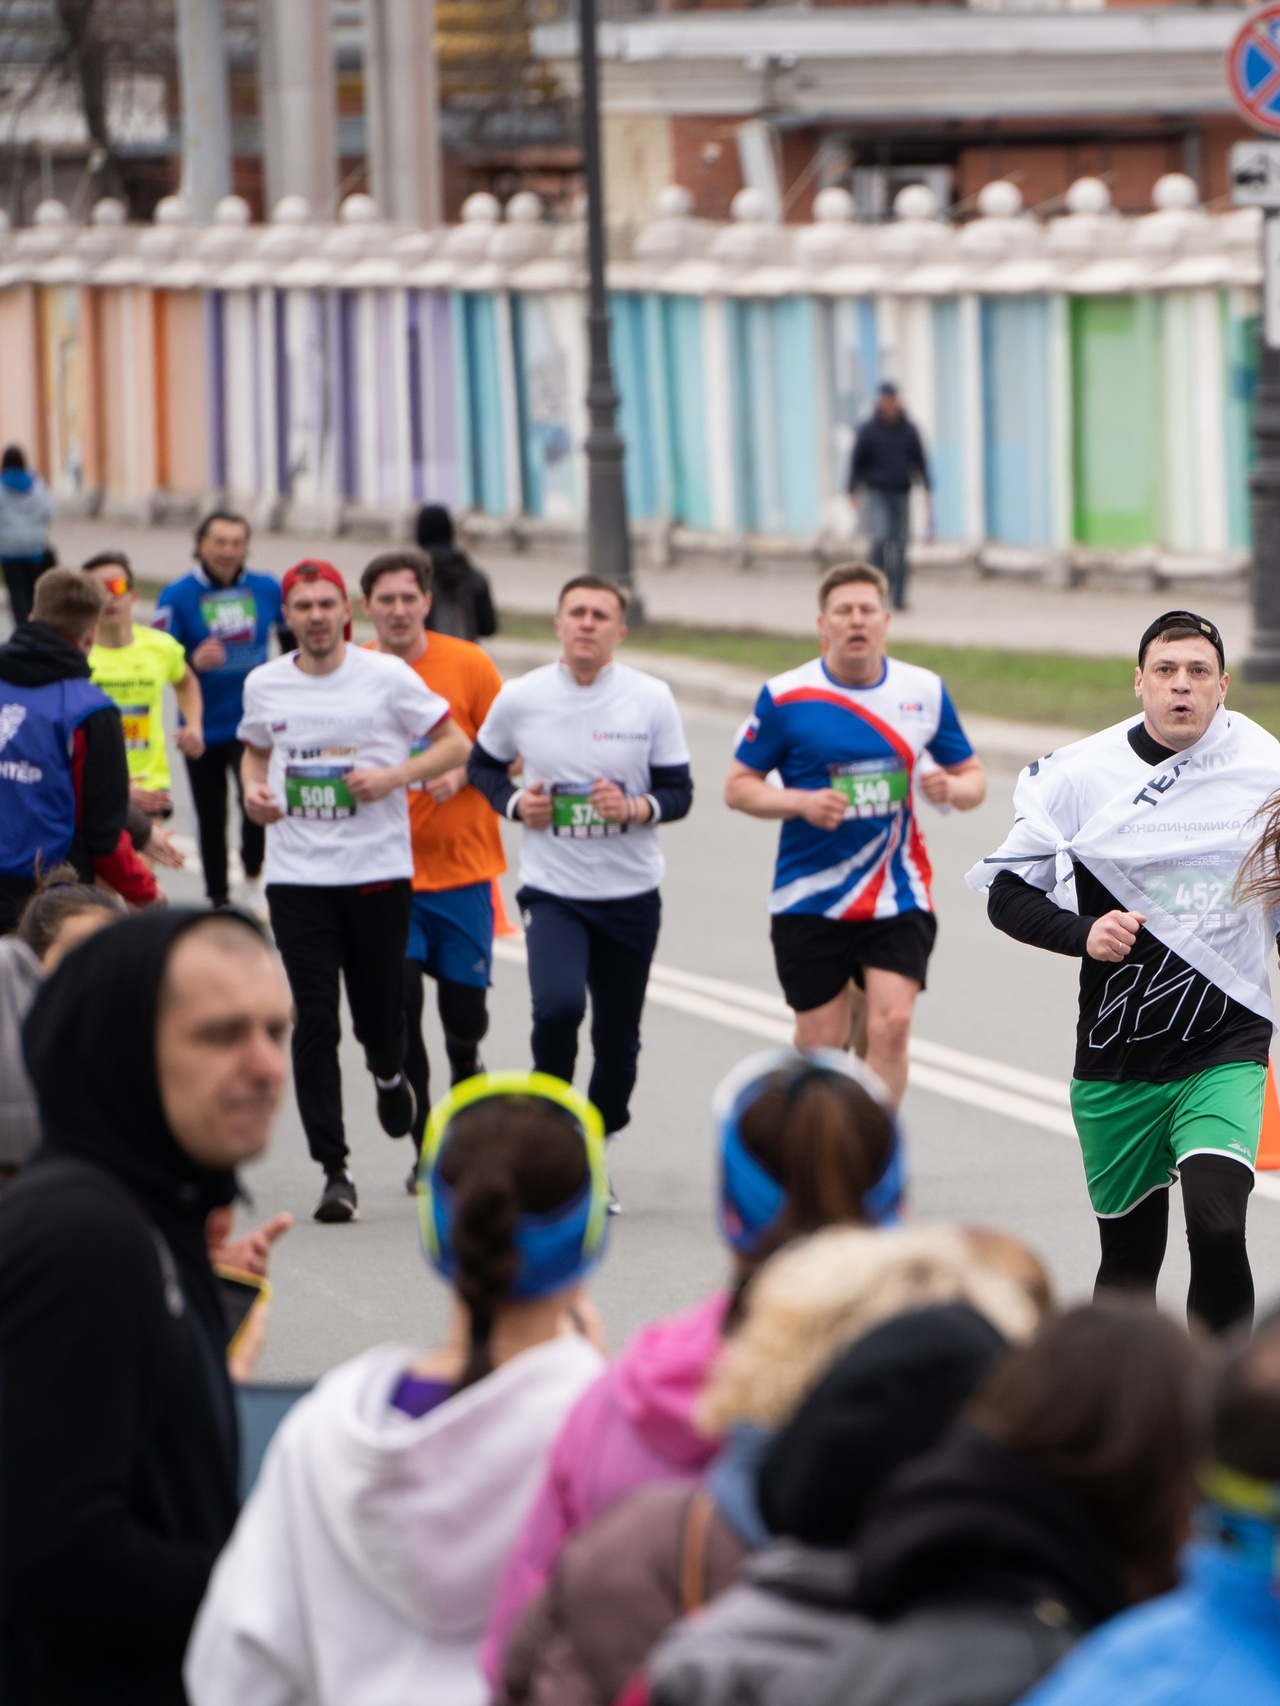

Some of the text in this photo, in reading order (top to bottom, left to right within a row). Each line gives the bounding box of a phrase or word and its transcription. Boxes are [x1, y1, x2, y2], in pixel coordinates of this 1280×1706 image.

[300, 785, 336, 807] 508
[852, 779, 890, 805] 349
[1117, 820, 1241, 835] ЕХНОДИНАМИКА
[1175, 882, 1225, 911] 452
